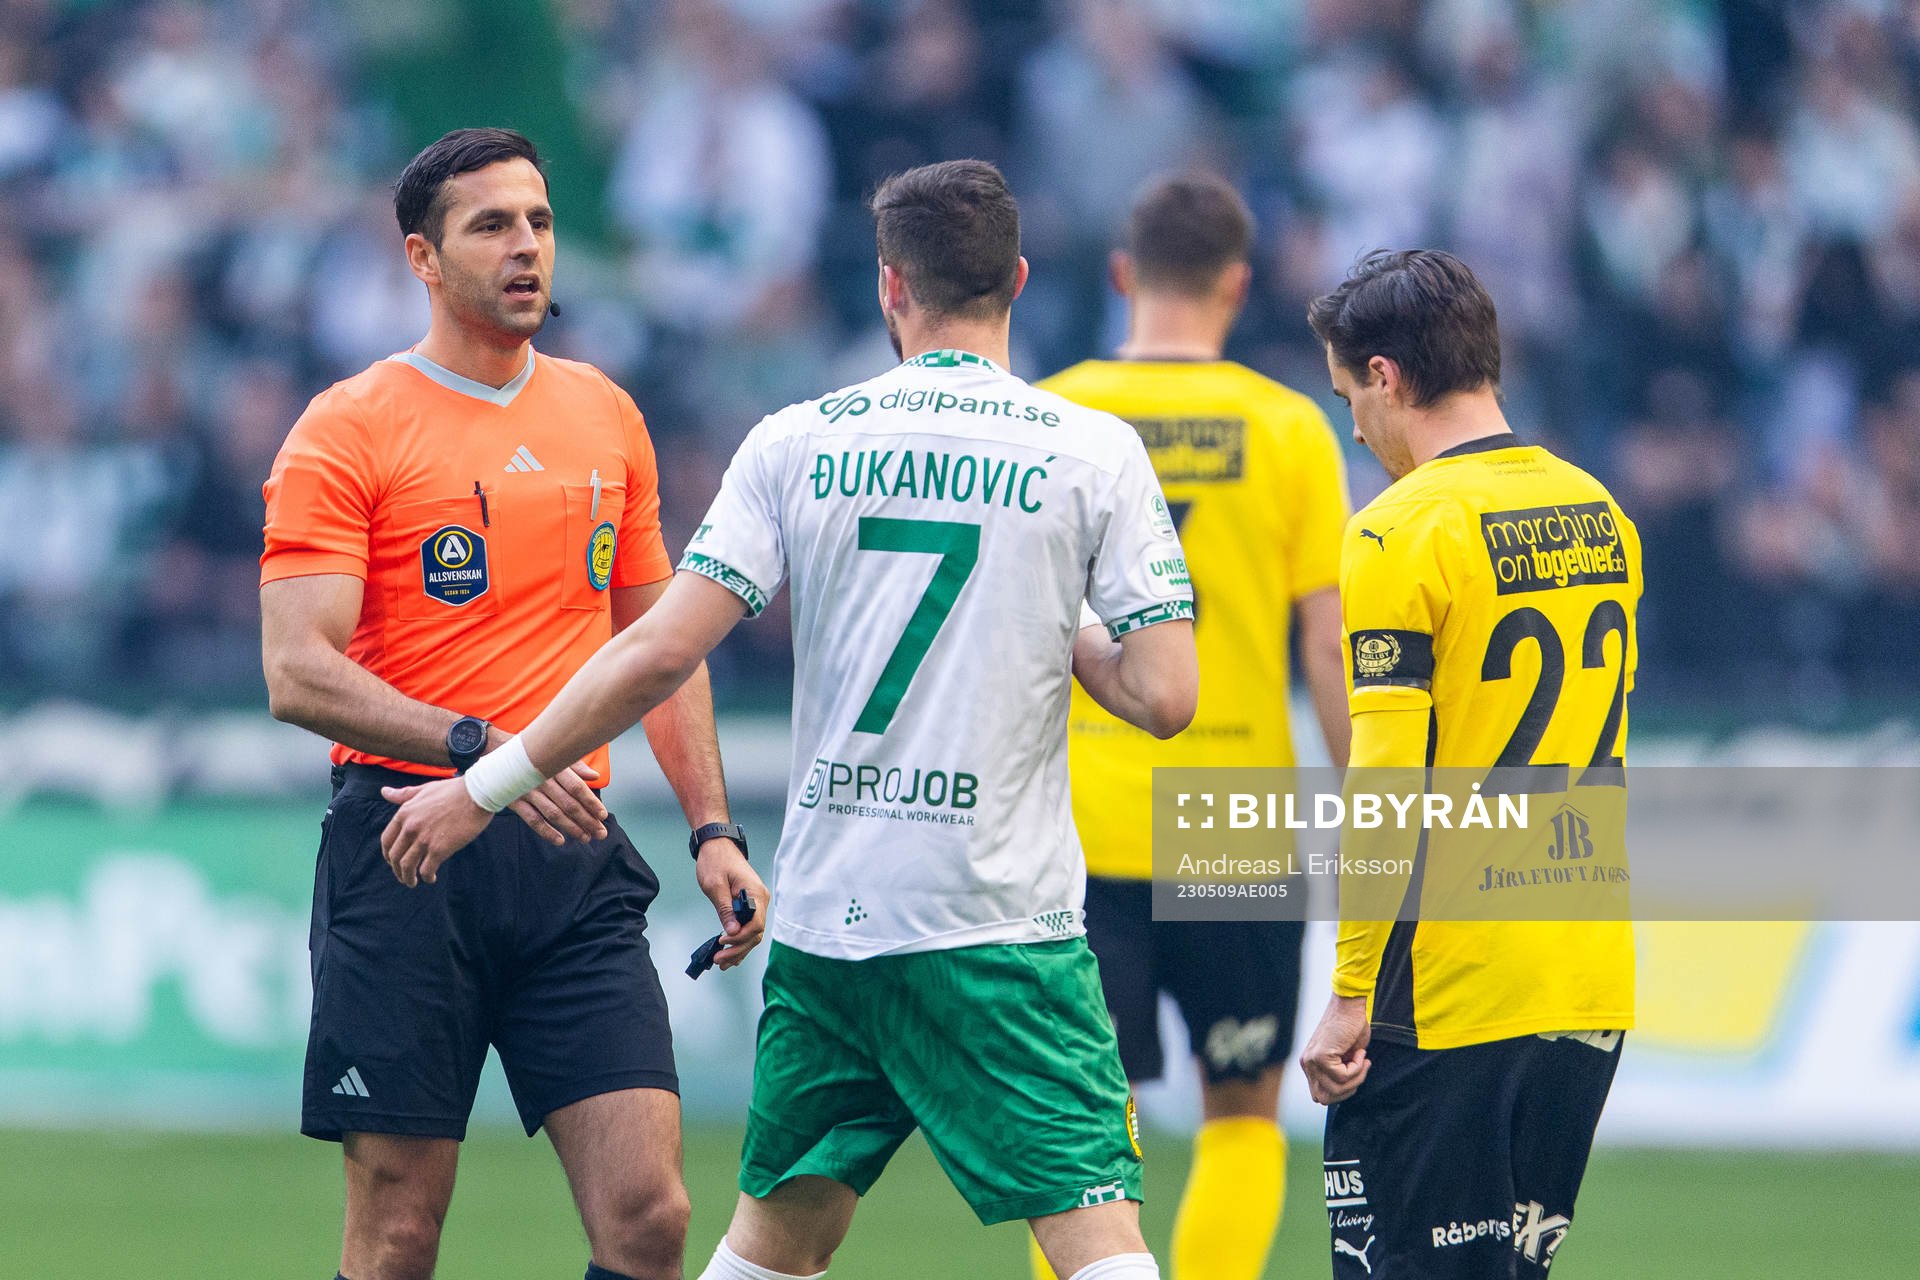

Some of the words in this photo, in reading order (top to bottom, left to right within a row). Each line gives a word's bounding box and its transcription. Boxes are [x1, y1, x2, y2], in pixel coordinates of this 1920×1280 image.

[880, 387, 1060, 427] digipant.se
[810, 449, 1057, 513] ĐUKANOVIĆ
[1486, 507, 1618, 549] marching
[429, 569, 482, 583] ALLSVENSKAN
[1497, 554, 1531, 583] on
[852, 517, 981, 735] 7
[1476, 599, 1627, 799] 22
[829, 763, 979, 809] PROJOB
[828, 803, 903, 820] PROFESSIONAL
[906, 810, 975, 826] WORKWEAR
[1337, 1210, 1375, 1231] living
